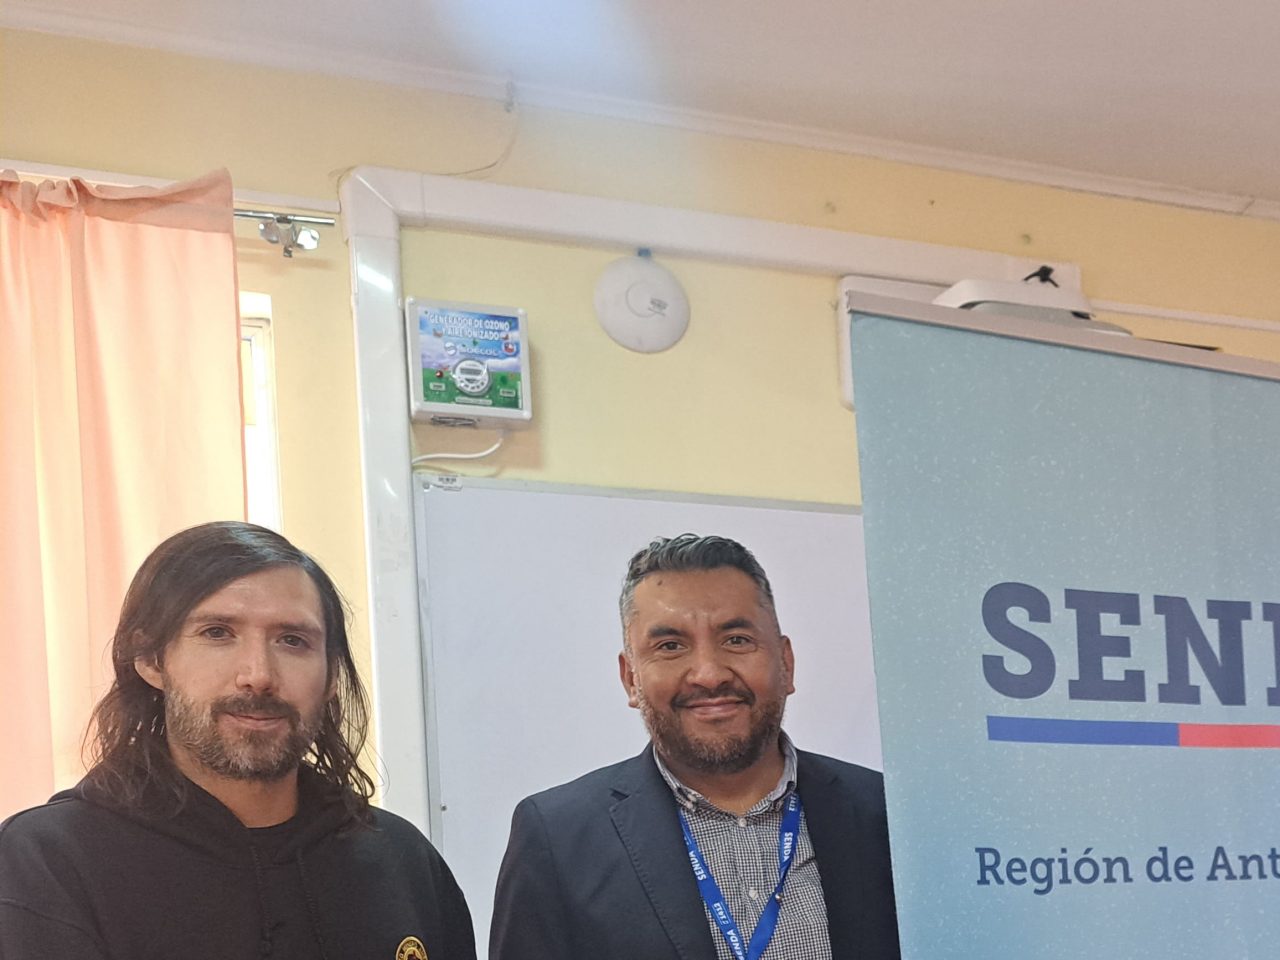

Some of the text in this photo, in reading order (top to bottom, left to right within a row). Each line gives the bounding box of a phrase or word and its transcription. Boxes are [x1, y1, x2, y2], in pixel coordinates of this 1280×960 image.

[428, 314, 510, 331] GENERADOR DE OZONO
[448, 328, 463, 338] AIRE
[464, 330, 500, 341] IONIZADO
[784, 832, 793, 862] SENDA
[688, 850, 707, 881] SENDA
[975, 845, 1133, 895] Región
[1146, 846, 1195, 883] de
